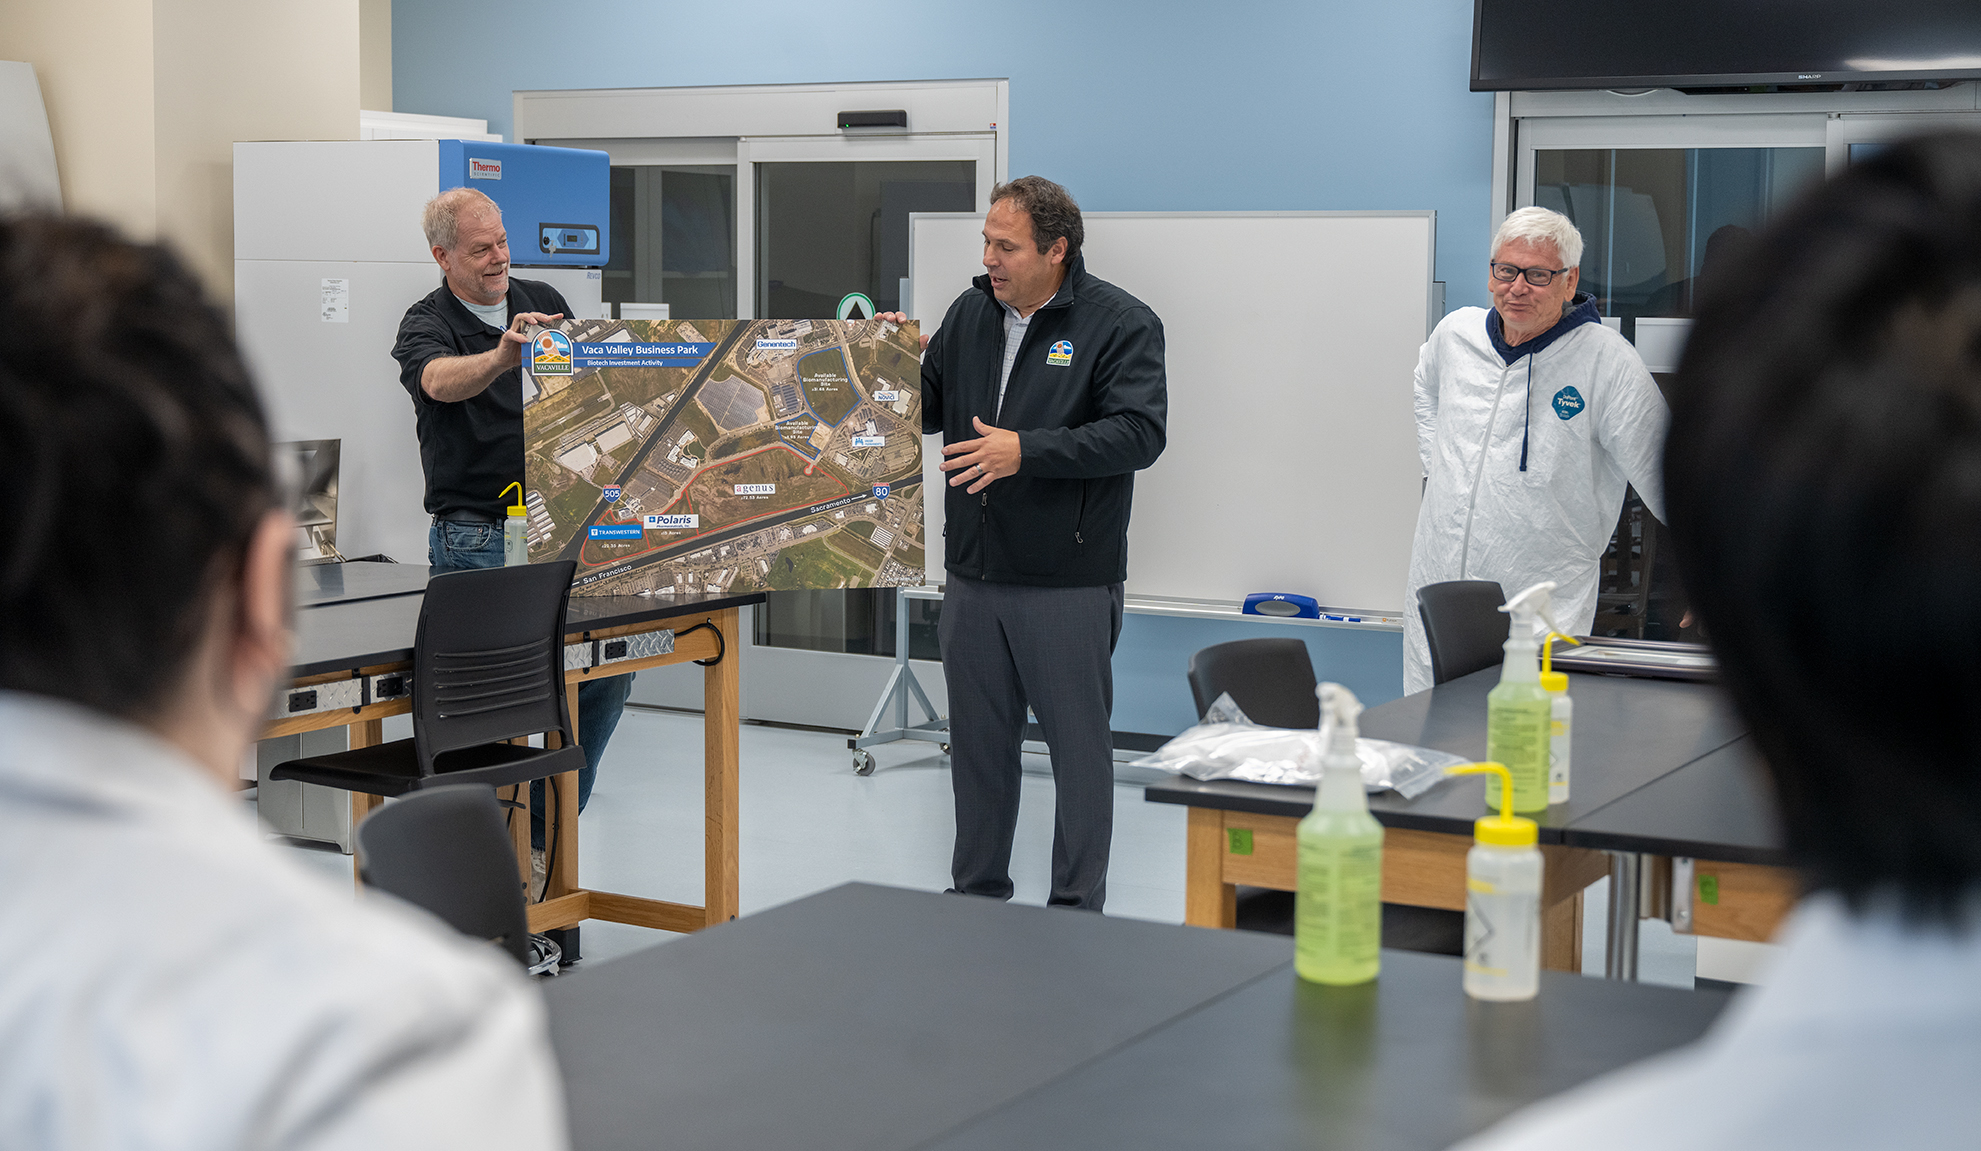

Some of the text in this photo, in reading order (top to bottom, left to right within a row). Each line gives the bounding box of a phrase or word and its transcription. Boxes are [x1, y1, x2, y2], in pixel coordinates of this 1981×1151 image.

[472, 161, 501, 173] Thermo
[757, 340, 796, 348] Genentech
[581, 344, 699, 357] Vaca Valley Business Park
[641, 359, 664, 367] Activity
[1557, 397, 1580, 409] Tyvek
[605, 490, 620, 498] 505
[736, 484, 774, 494] agenus
[875, 487, 888, 496] 80
[810, 498, 851, 514] Sacramento
[656, 515, 692, 524] Polaris
[583, 565, 632, 585] San Francisco
